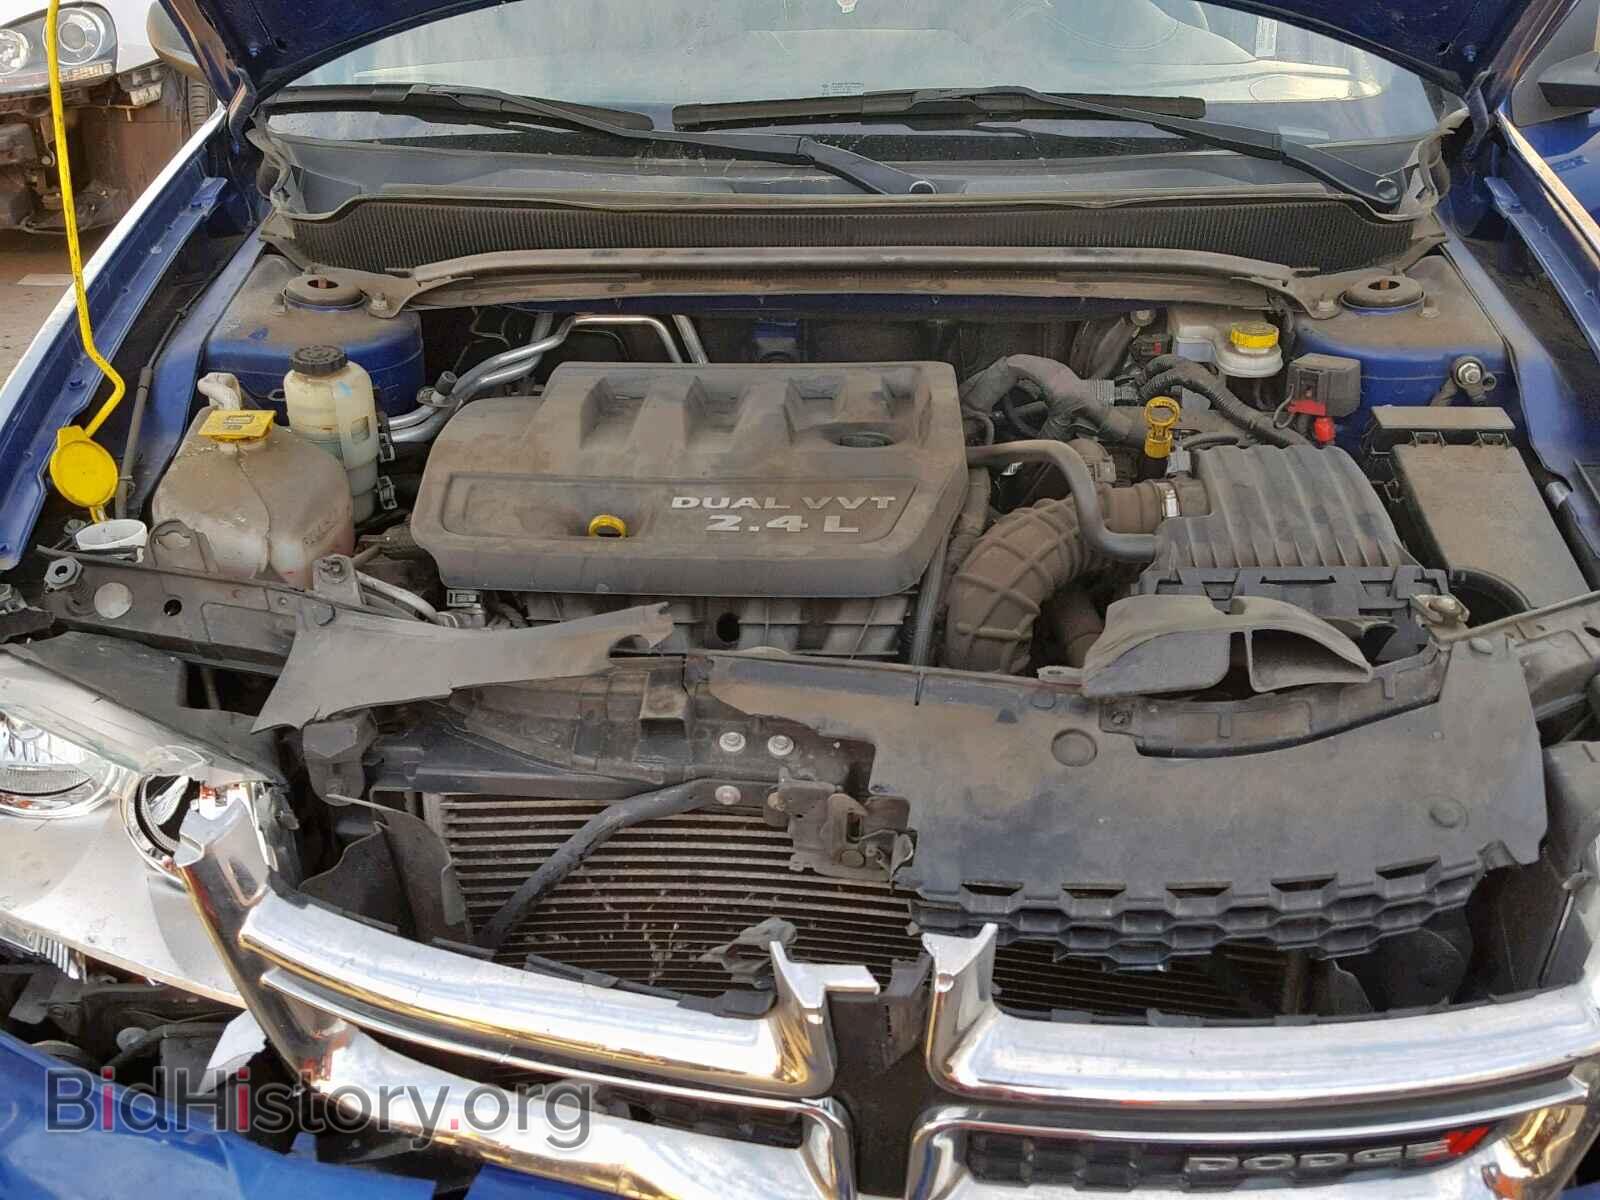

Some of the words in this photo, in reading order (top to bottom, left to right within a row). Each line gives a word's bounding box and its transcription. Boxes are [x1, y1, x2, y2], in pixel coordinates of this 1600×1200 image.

[672, 497, 791, 509] DUAL
[802, 497, 896, 509] VVT
[1187, 1139, 1450, 1171] DODGE
